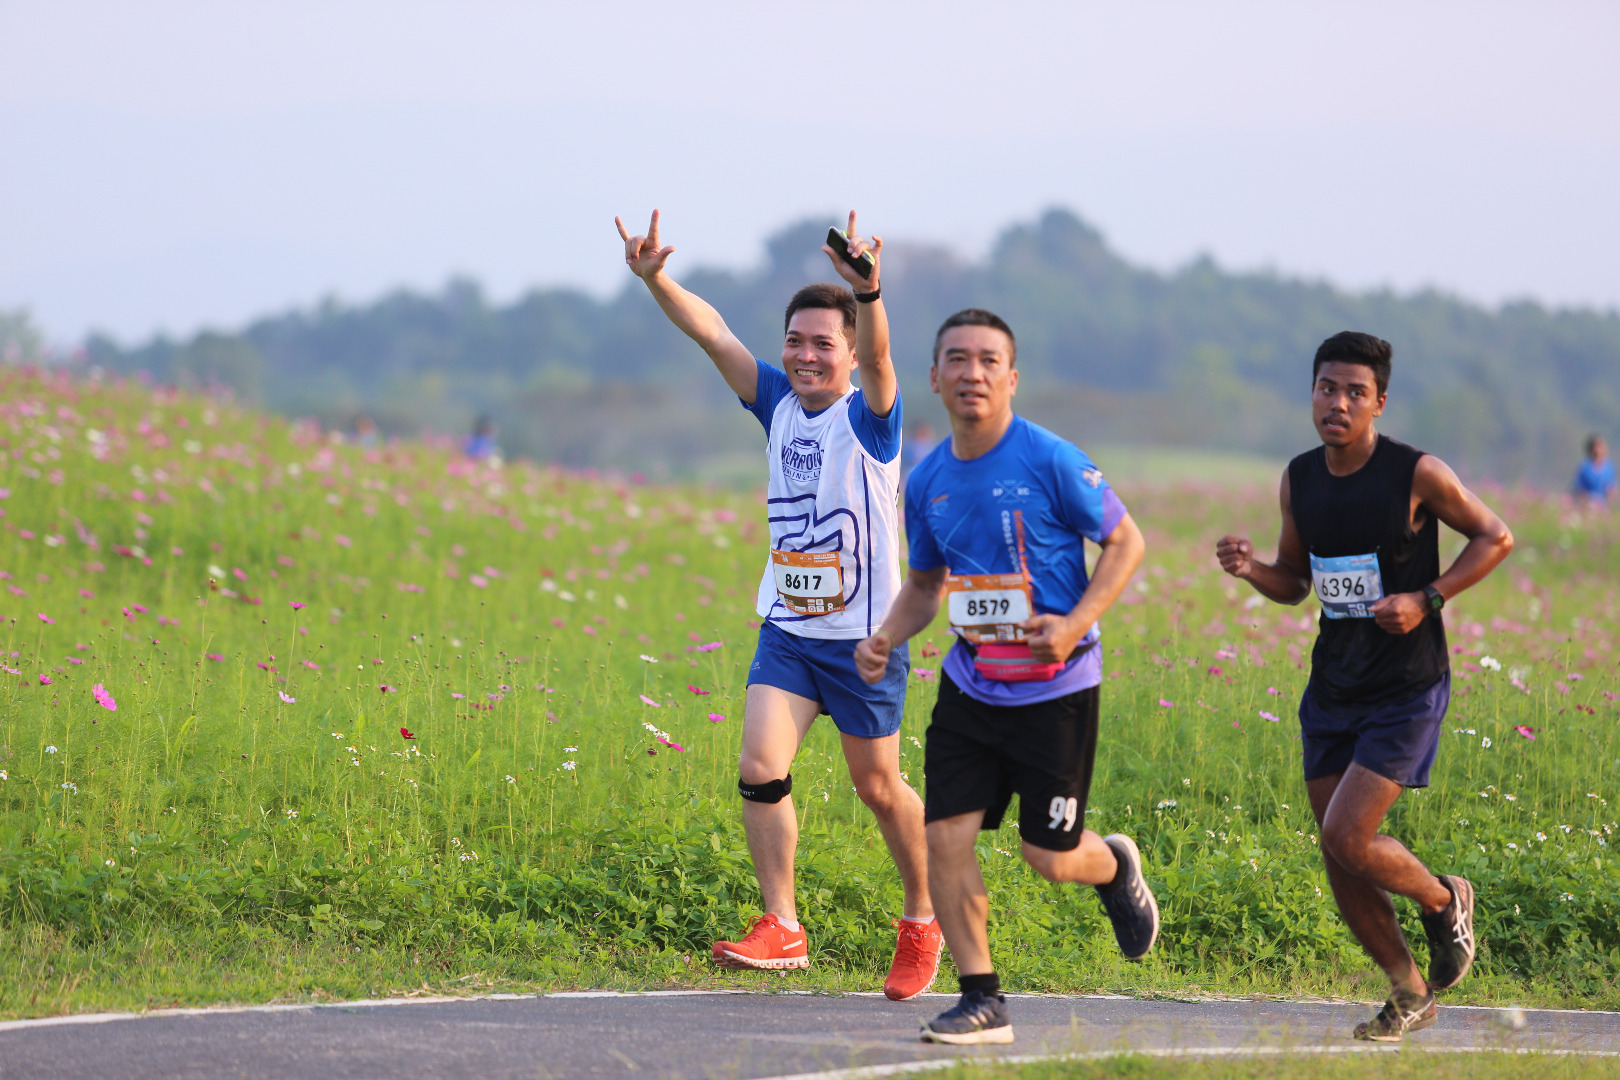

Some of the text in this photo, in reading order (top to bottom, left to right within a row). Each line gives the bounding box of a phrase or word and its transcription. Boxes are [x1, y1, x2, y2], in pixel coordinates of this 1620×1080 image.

[1001, 510, 1014, 545] CROSS
[785, 573, 822, 590] 8617
[1321, 576, 1365, 597] 6396
[967, 599, 1010, 616] 8579
[1048, 796, 1078, 832] 99
